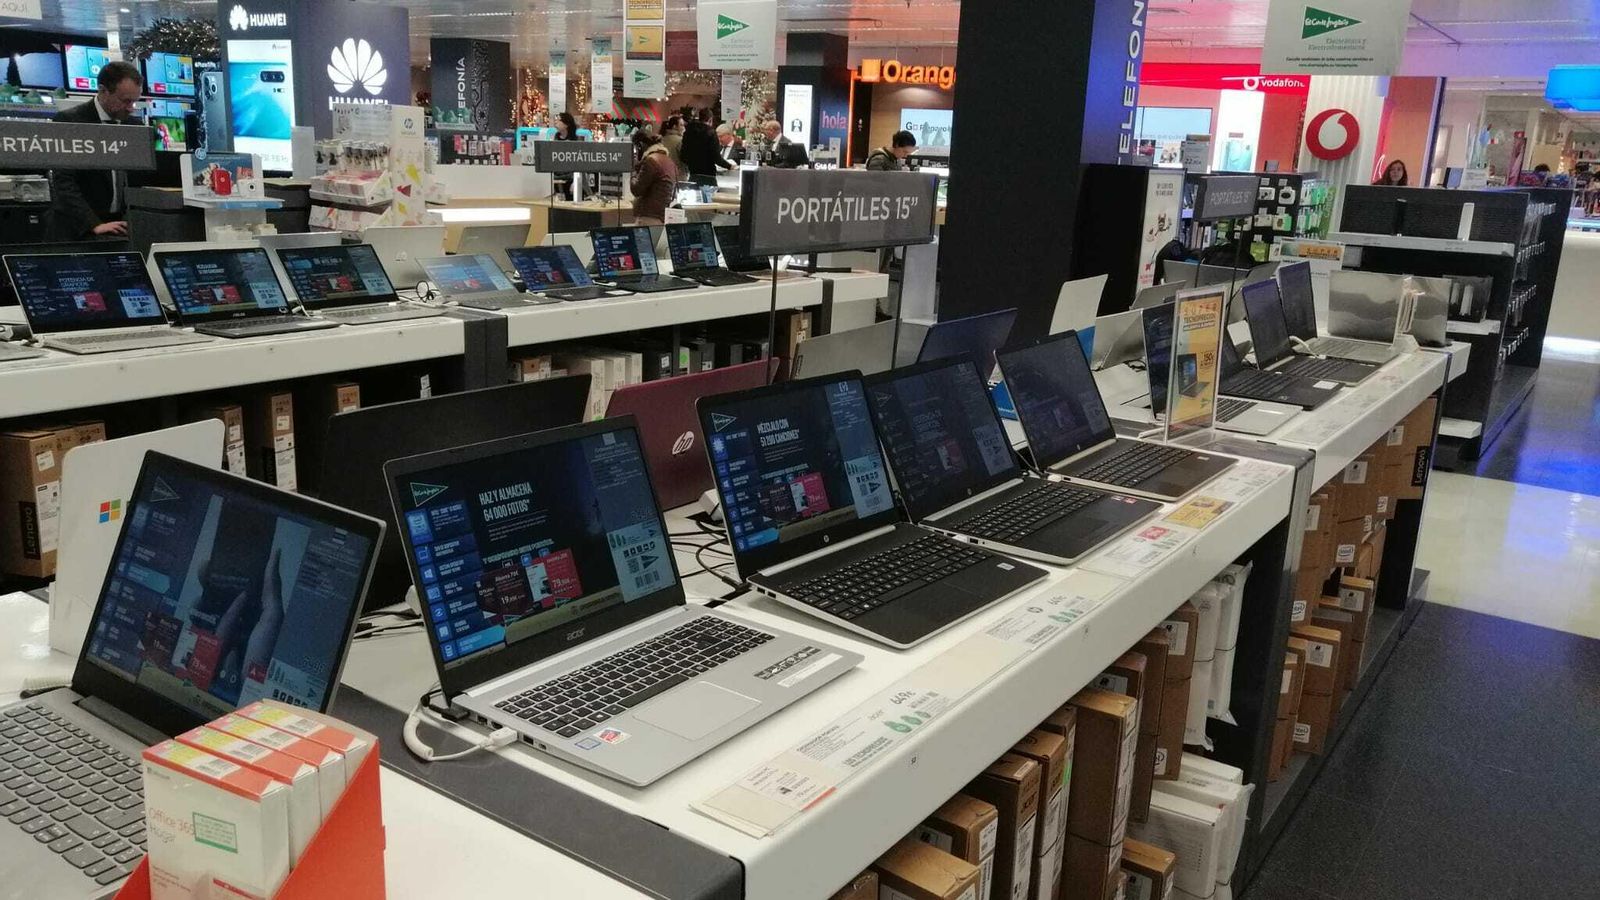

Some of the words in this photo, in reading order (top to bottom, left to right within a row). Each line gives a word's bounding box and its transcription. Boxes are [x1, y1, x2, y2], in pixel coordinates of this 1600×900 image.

[250, 13, 287, 27] HUAWEI
[883, 60, 956, 90] Orang
[822, 110, 847, 129] hola
[0, 135, 96, 154] RTÁTILES
[551, 150, 608, 164] PORTÁTILES
[777, 191, 889, 224] PORTÁTILES
[672, 431, 695, 455] hp
[1414, 449, 1425, 483] Lenovo
[479, 490, 494, 505] HAZ
[566, 627, 586, 642] acer
[149, 807, 176, 827] Office
